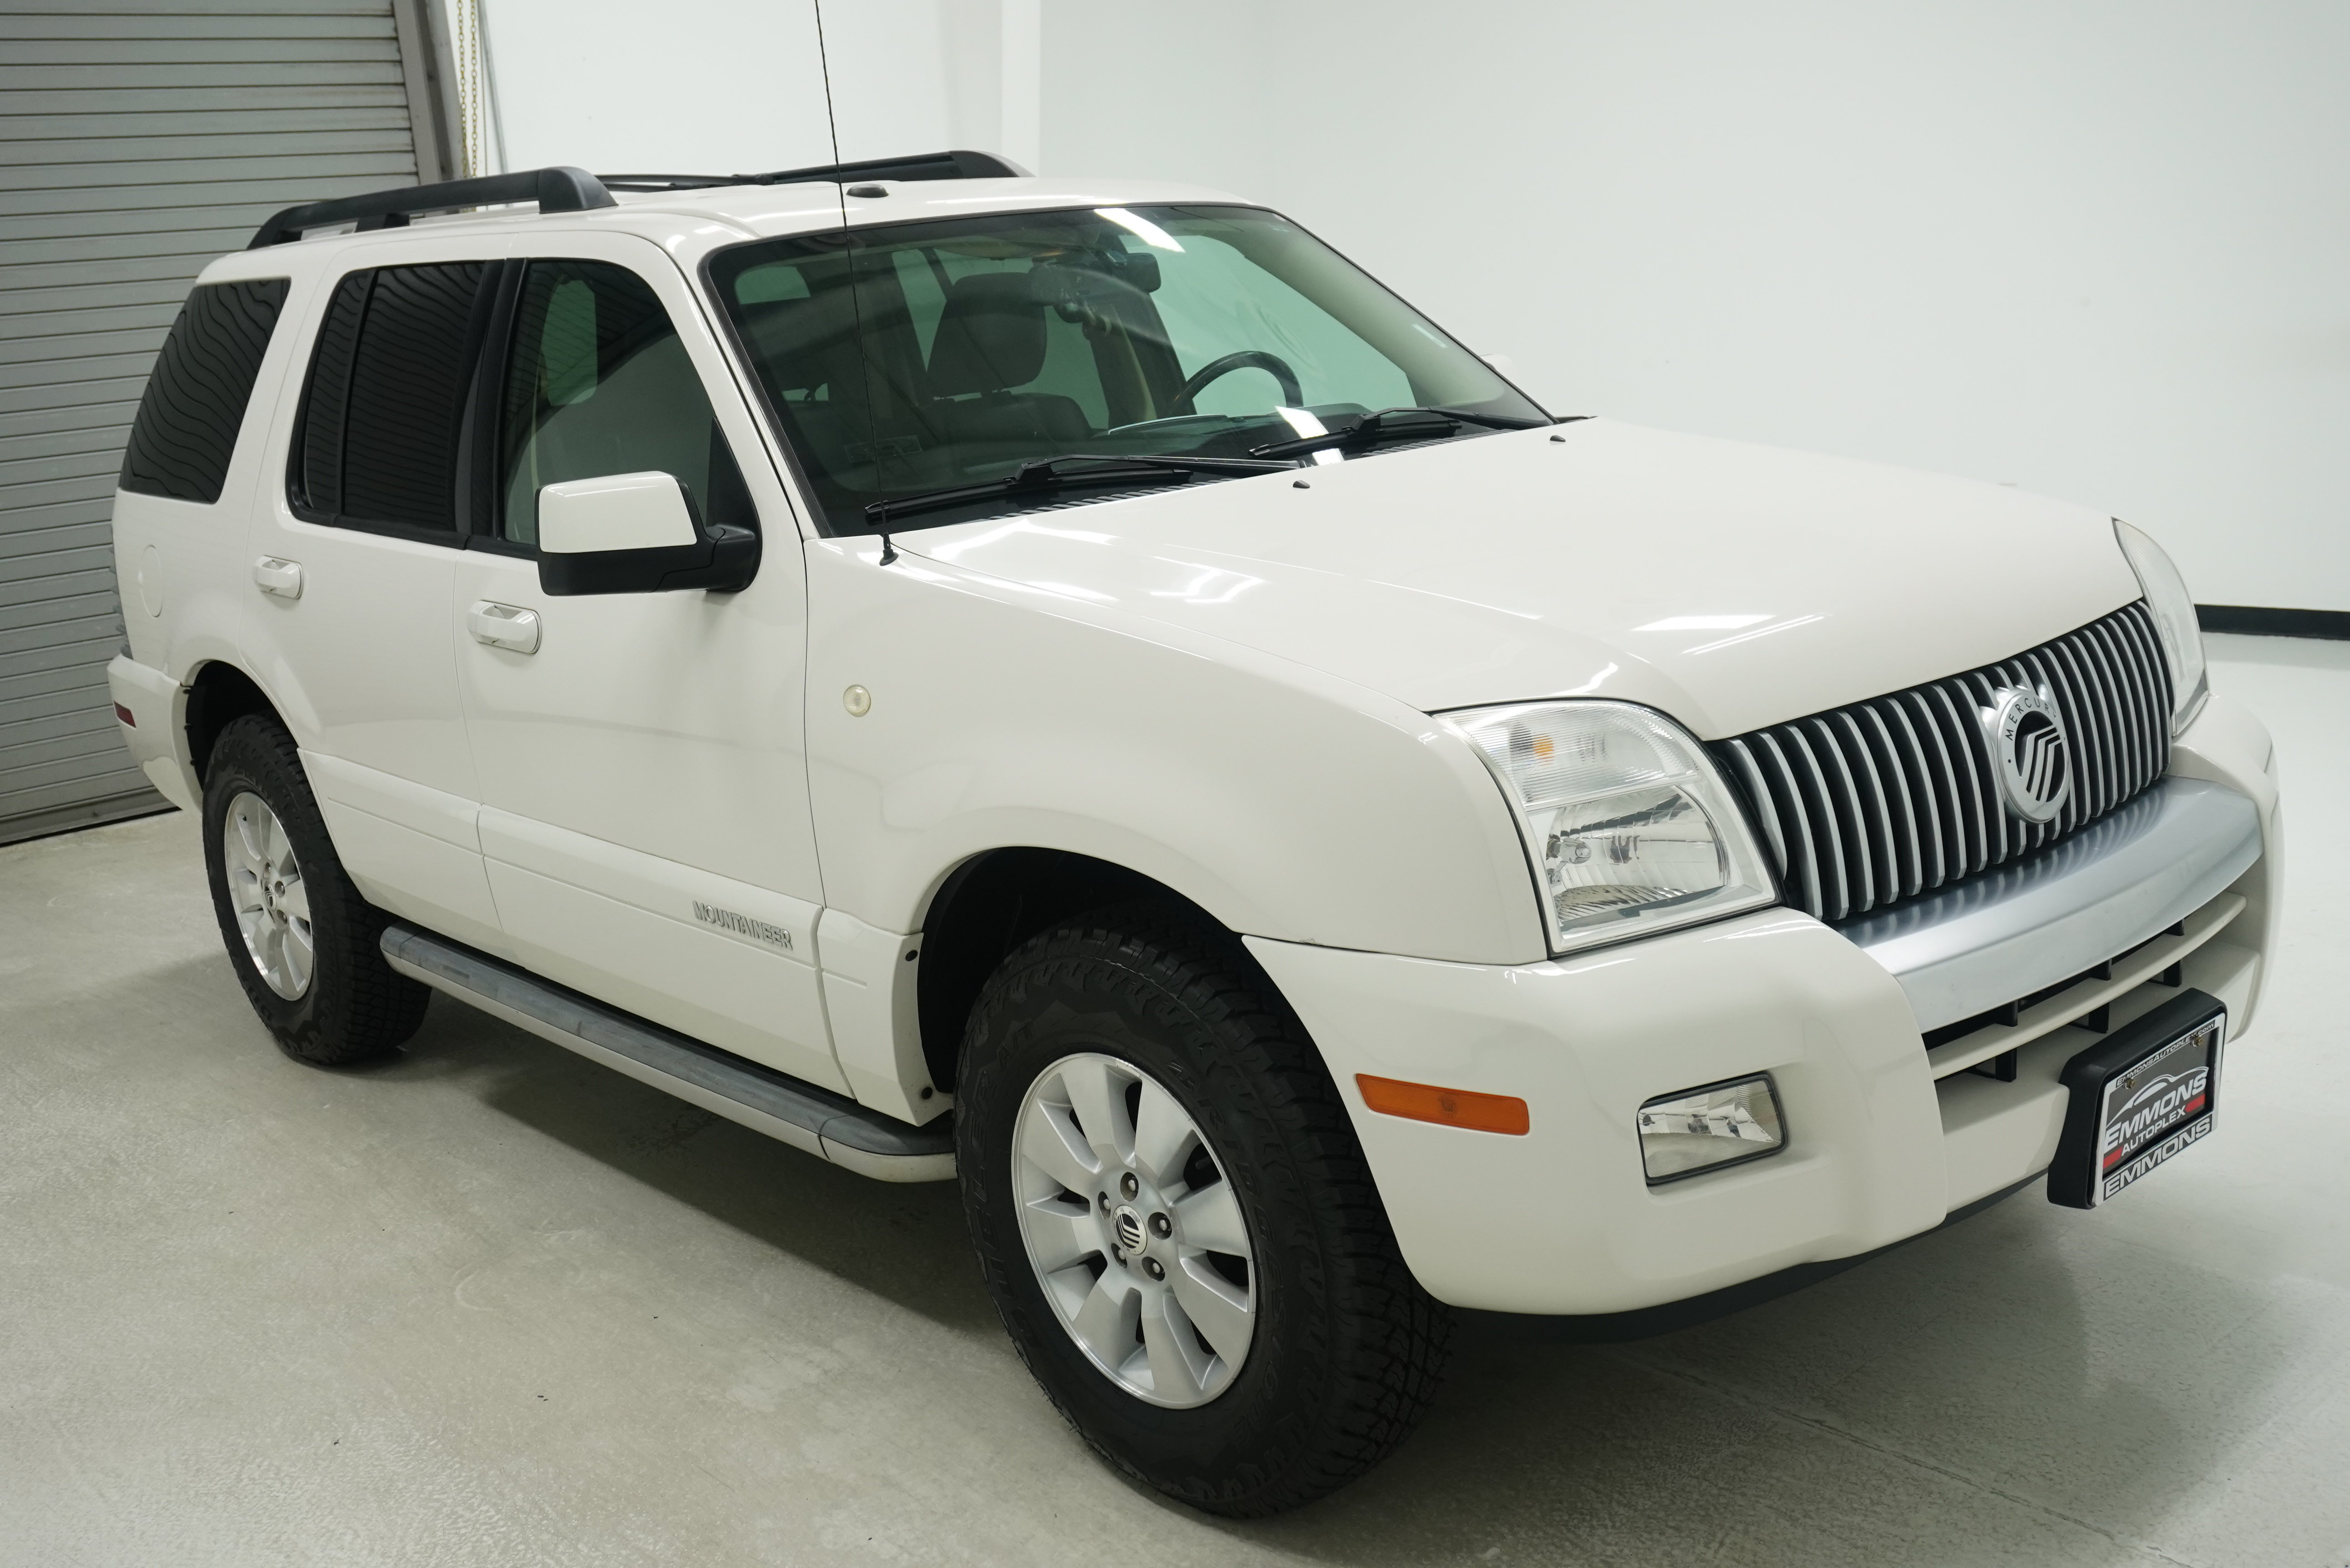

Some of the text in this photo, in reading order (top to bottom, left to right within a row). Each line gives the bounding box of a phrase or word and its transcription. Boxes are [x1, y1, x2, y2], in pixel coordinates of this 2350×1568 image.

[2005, 698, 2057, 741] MERCURY
[693, 900, 793, 950] MOUNTAINEER
[2105, 1074, 2207, 1149] EMMONS
[2121, 1105, 2186, 1156] AUTOPLEX
[969, 1018, 1045, 1349] DUELER A/T
[2105, 1118, 2210, 1197] EMMONS
[1167, 1057, 1287, 1452] BRIDGESTONE
